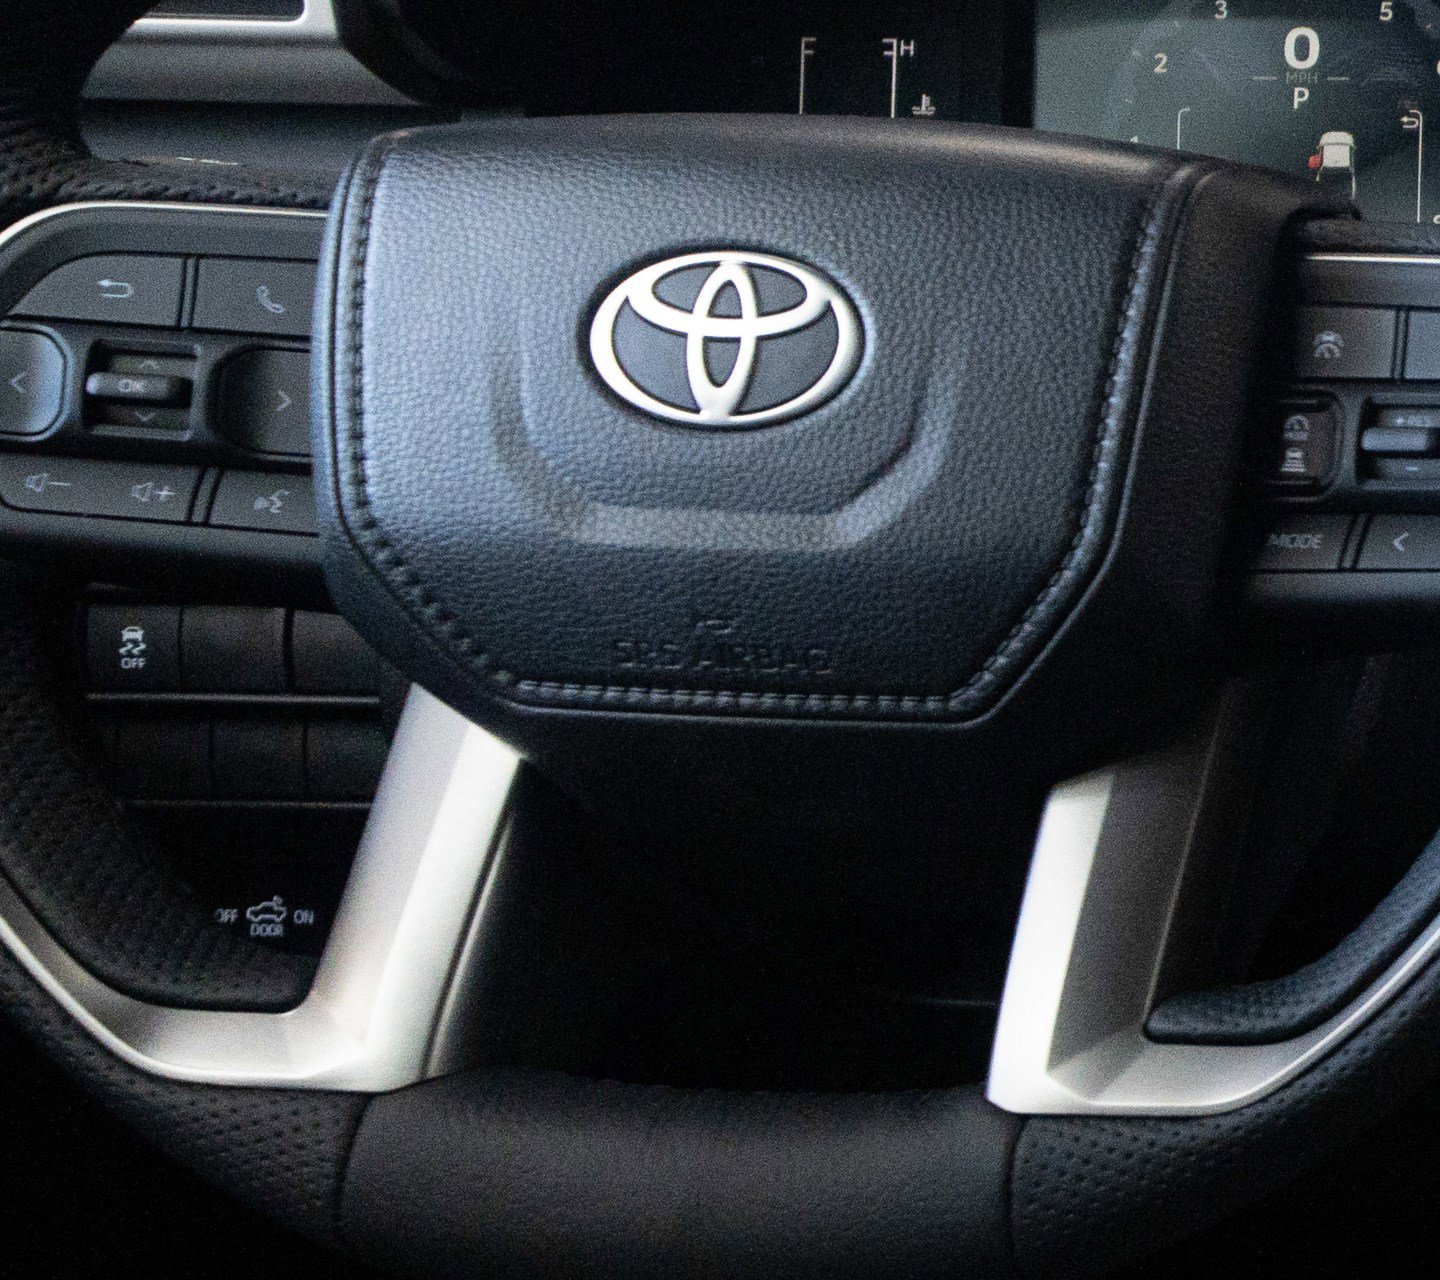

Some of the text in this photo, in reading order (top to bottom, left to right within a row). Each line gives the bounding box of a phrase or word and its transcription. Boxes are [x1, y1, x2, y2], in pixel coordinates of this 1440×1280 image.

[1214, 1, 1228, 20] 3
[1380, 1, 1393, 21] 5
[1283, 25, 1320, 70] 0
[1154, 53, 1168, 73] 2
[1286, 71, 1318, 84] MPH
[1294, 87, 1310, 109] P
[1267, 533, 1324, 549] MODE
[121, 657, 146, 669] OFF
